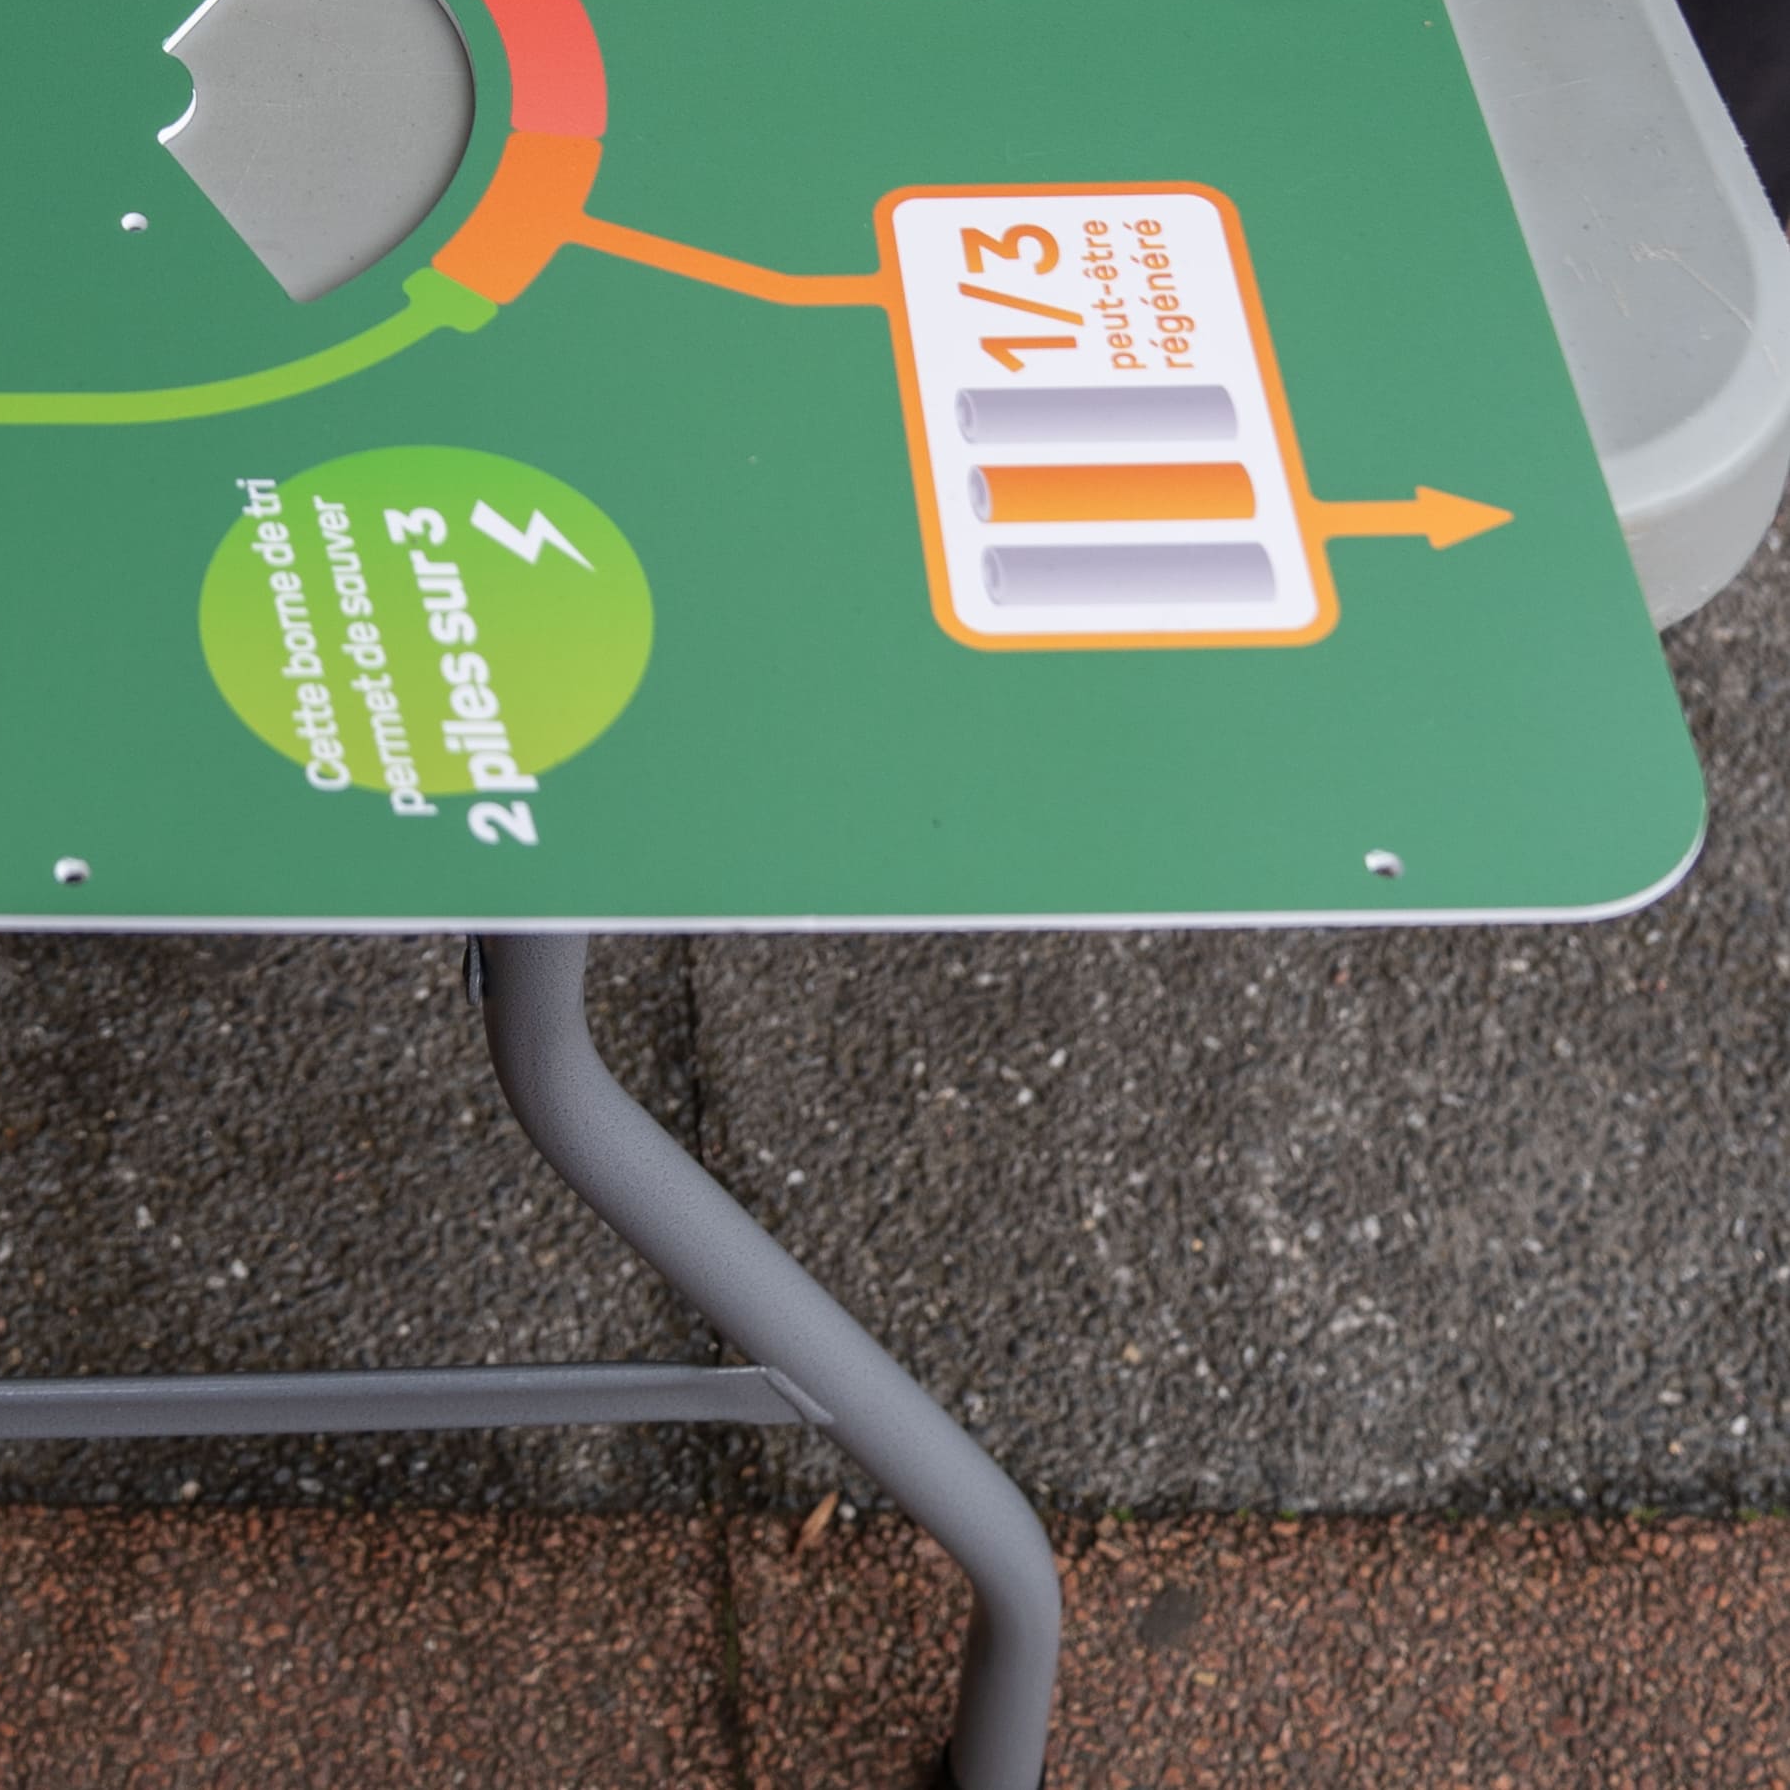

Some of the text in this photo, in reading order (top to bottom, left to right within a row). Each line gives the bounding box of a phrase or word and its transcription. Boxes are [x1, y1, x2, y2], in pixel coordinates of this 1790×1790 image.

[957, 223, 1085, 374] 1/3
[1082, 219, 1148, 372] peut-être
[1123, 217, 1195, 370] régénéré
[236, 478, 352, 791] Cette borne de tri
[312, 494, 439, 817] permet de sauver
[383, 505, 540, 846] 2 piles sur 3
